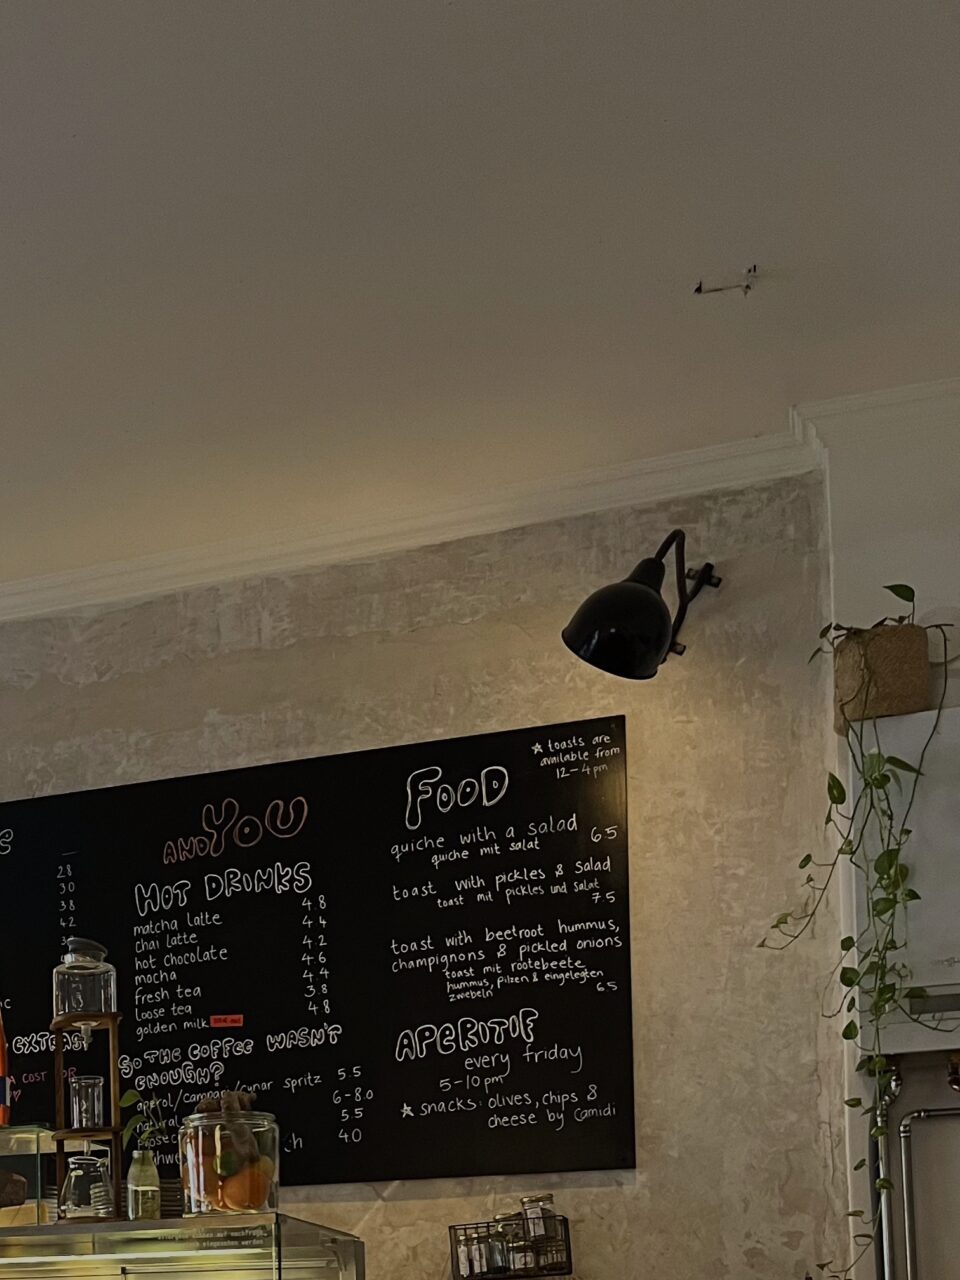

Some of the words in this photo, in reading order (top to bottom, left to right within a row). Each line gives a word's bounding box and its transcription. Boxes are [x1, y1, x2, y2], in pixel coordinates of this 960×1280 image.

[540, 749, 589, 767] available
[595, 745, 621, 759] from
[547, 735, 585, 753] toasts
[592, 734, 612, 746] are
[162, 836, 210, 864] AND
[201, 796, 309, 857] YOU
[390, 834, 446, 863] quiche
[459, 826, 497, 845] with
[505, 826, 515, 838] a
[528, 812, 578, 836] salad
[431, 849, 470, 869] quiche
[480, 845, 501, 857] mit
[509, 836, 541, 851] salat
[134, 880, 191, 917] HOT
[204, 861, 312, 901] DRINKS
[392, 881, 437, 901] toast
[455, 875, 486, 891] with
[495, 867, 546, 892] pickles
[437, 895, 464, 909] toast
[477, 891, 493, 903] mit
[505, 884, 545, 905] pickles
[550, 882, 567, 894] und
[133, 919, 178, 936] matcha
[187, 912, 223, 927] latte
[135, 938, 159, 953] chai
[166, 932, 198, 948] latte
[390, 936, 435, 955] toast
[445, 930, 473, 947] with
[485, 924, 544, 942] beetroot
[557, 919, 620, 935] hummus,
[135, 955, 156, 971] hot
[163, 945, 228, 967] chocolate
[392, 949, 486, 973] champignons
[519, 939, 567, 961] pickled
[576, 936, 623, 950] onions
[135, 970, 177, 986] mocha
[445, 966, 475, 980] toast
[483, 963, 502, 975] mit
[544, 967, 604, 986] eingelegten
[135, 986, 170, 1005] fresh
[176, 985, 202, 999] tea
[135, 1007, 166, 1022] loose
[171, 1003, 192, 1016] tea
[136, 1021, 177, 1042] golden
[183, 1018, 209, 1031] milk
[395, 1007, 539, 1062] APERITIF
[144, 1047, 182, 1065] THE
[188, 1037, 254, 1061] COFFEE
[464, 1052, 510, 1077] every
[522, 1042, 583, 1074] friday
[22, 1071, 48, 1084] COST
[134, 1061, 225, 1091] ENOUGH?
[542, 1090, 579, 1111] chips
[488, 1110, 538, 1129] cheese
[546, 1108, 565, 1131] by
